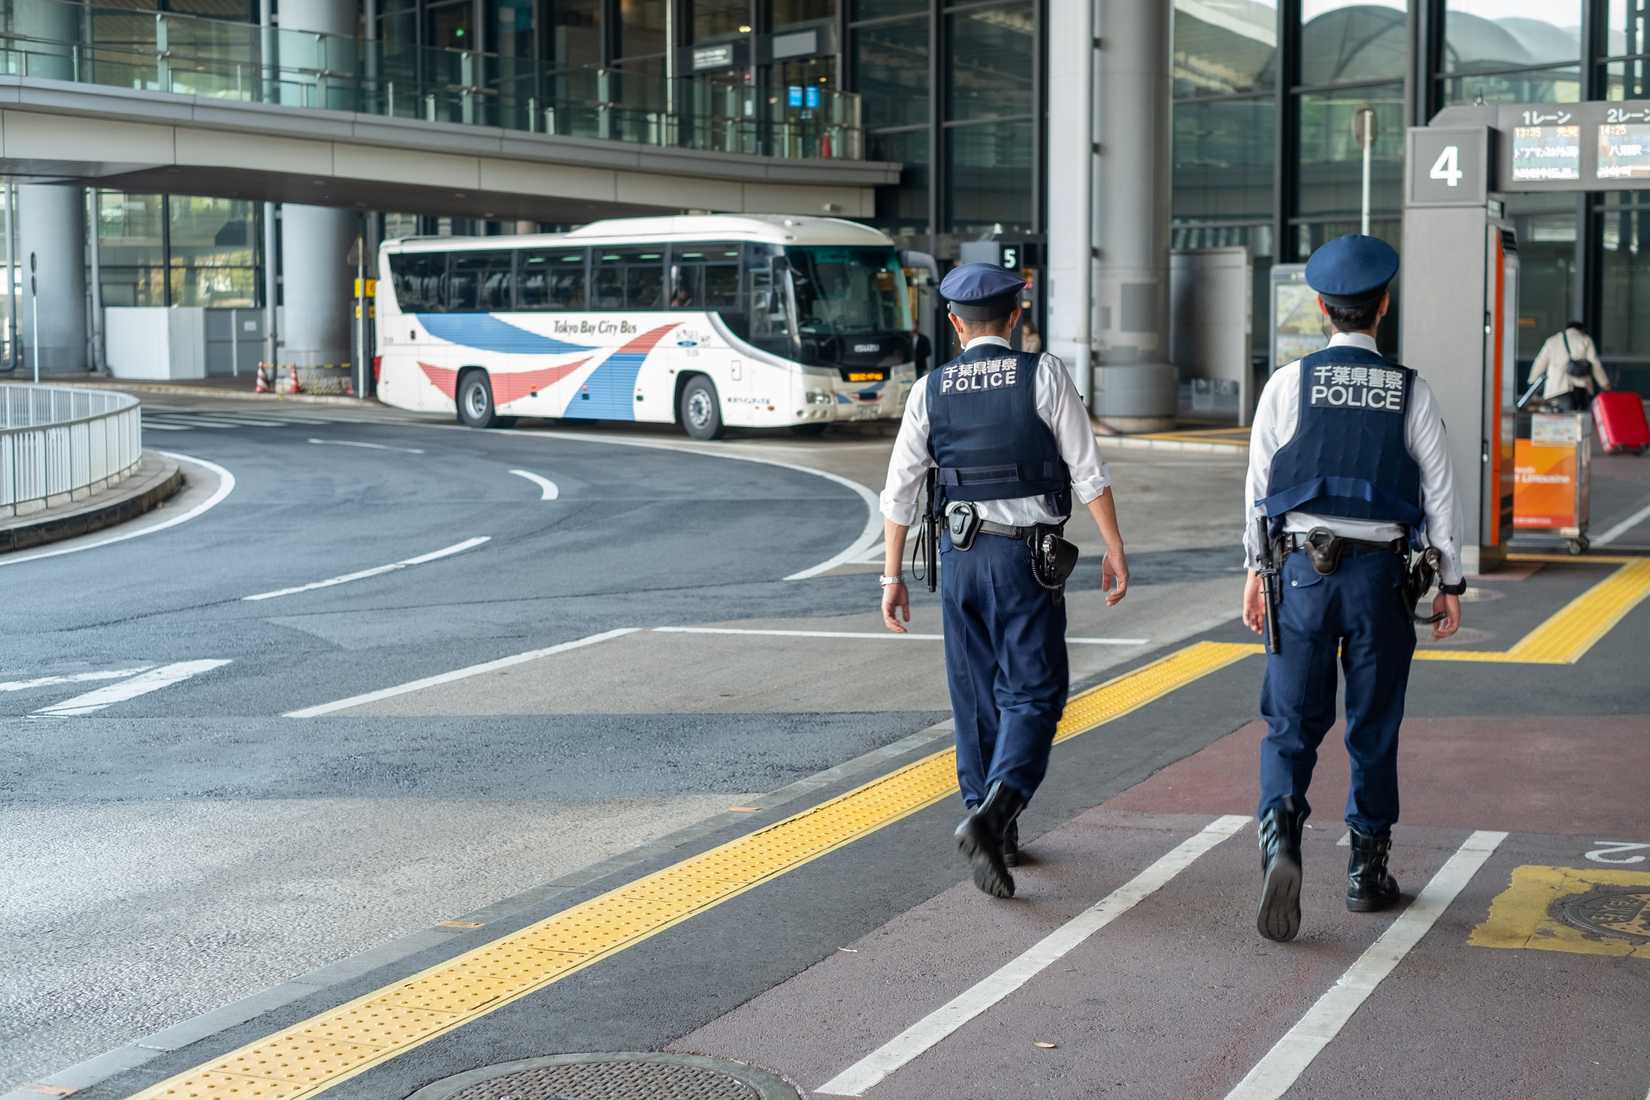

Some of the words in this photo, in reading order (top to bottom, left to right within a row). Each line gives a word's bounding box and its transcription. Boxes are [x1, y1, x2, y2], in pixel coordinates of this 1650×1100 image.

[1522, 110, 1571, 125] 1レーン
[1429, 146, 1463, 187] 4
[1004, 248, 1016, 269] 5
[553, 320, 578, 336] Tokyo
[580, 320, 596, 336] Bay
[598, 320, 618, 336] City
[620, 320, 637, 334] Bus
[944, 358, 1017, 379] 千葉県警察
[1313, 365, 1403, 390] 千葉県警察
[942, 371, 1017, 393] POLICE
[1311, 385, 1402, 410] POLICE
